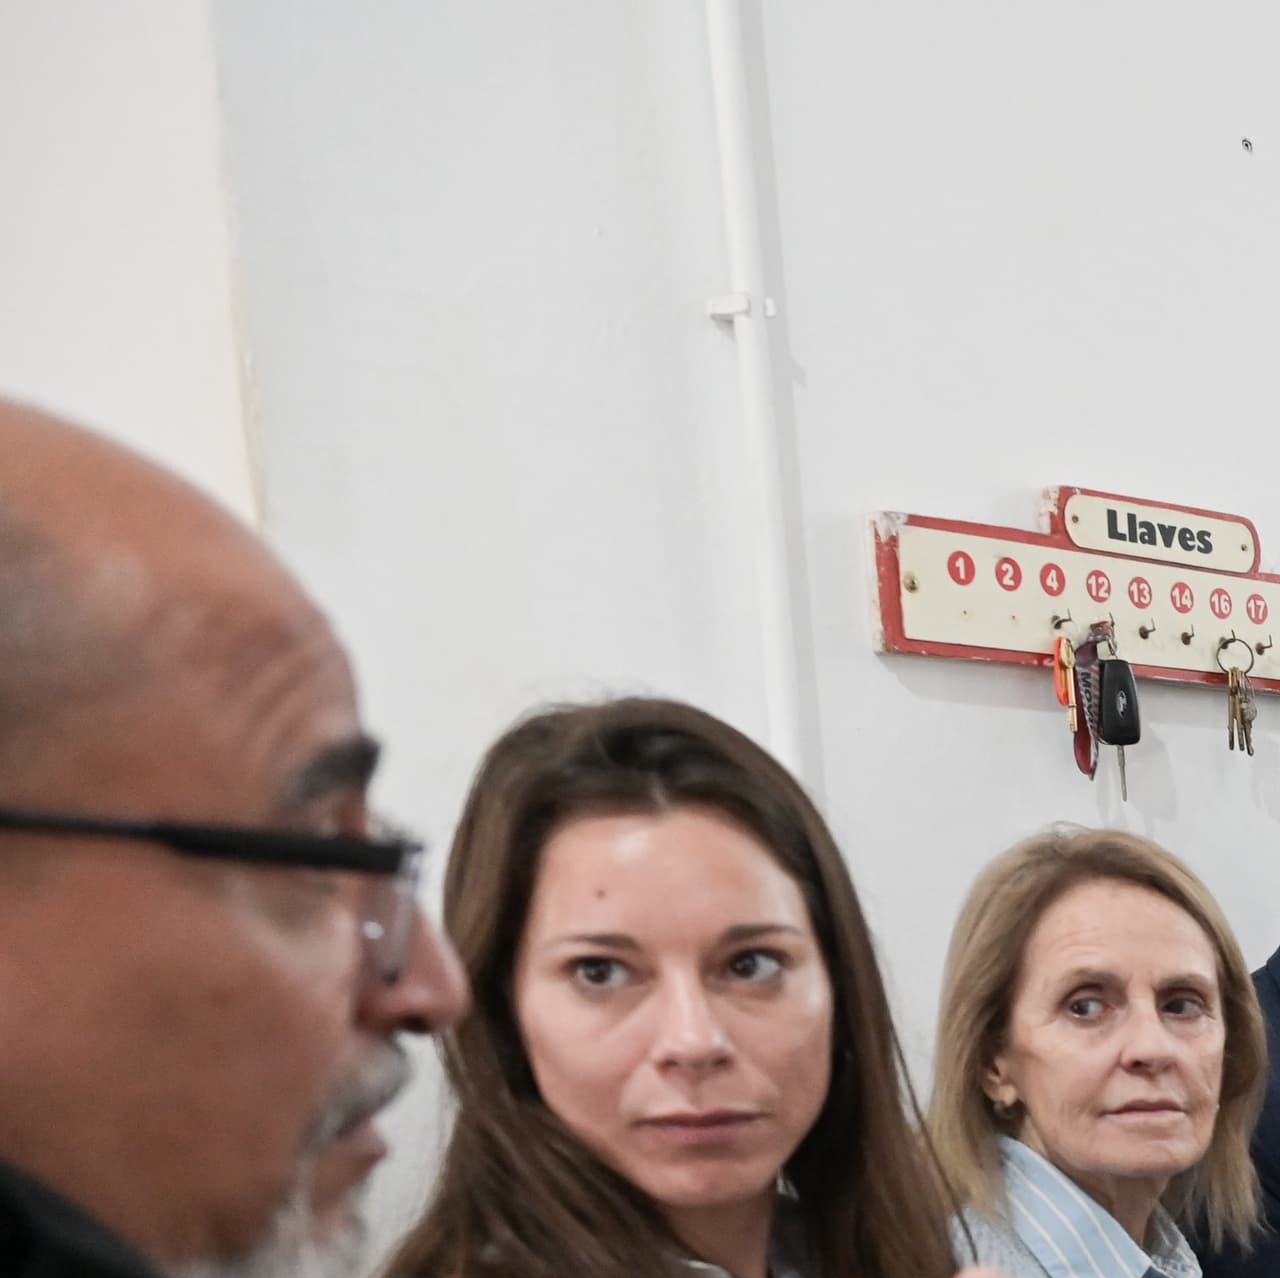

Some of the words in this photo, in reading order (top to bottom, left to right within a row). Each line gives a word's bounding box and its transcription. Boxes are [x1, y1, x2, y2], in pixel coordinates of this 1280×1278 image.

[1106, 508, 1213, 554] Llaves
[954, 556, 966, 580] 1
[1001, 562, 1015, 586] 2
[1046, 569, 1059, 591] 4
[1087, 575, 1109, 599] 12
[1130, 581, 1150, 604] 13
[1172, 587, 1192, 609] 14
[1212, 592, 1230, 615] 16
[1248, 598, 1265, 620] 17
